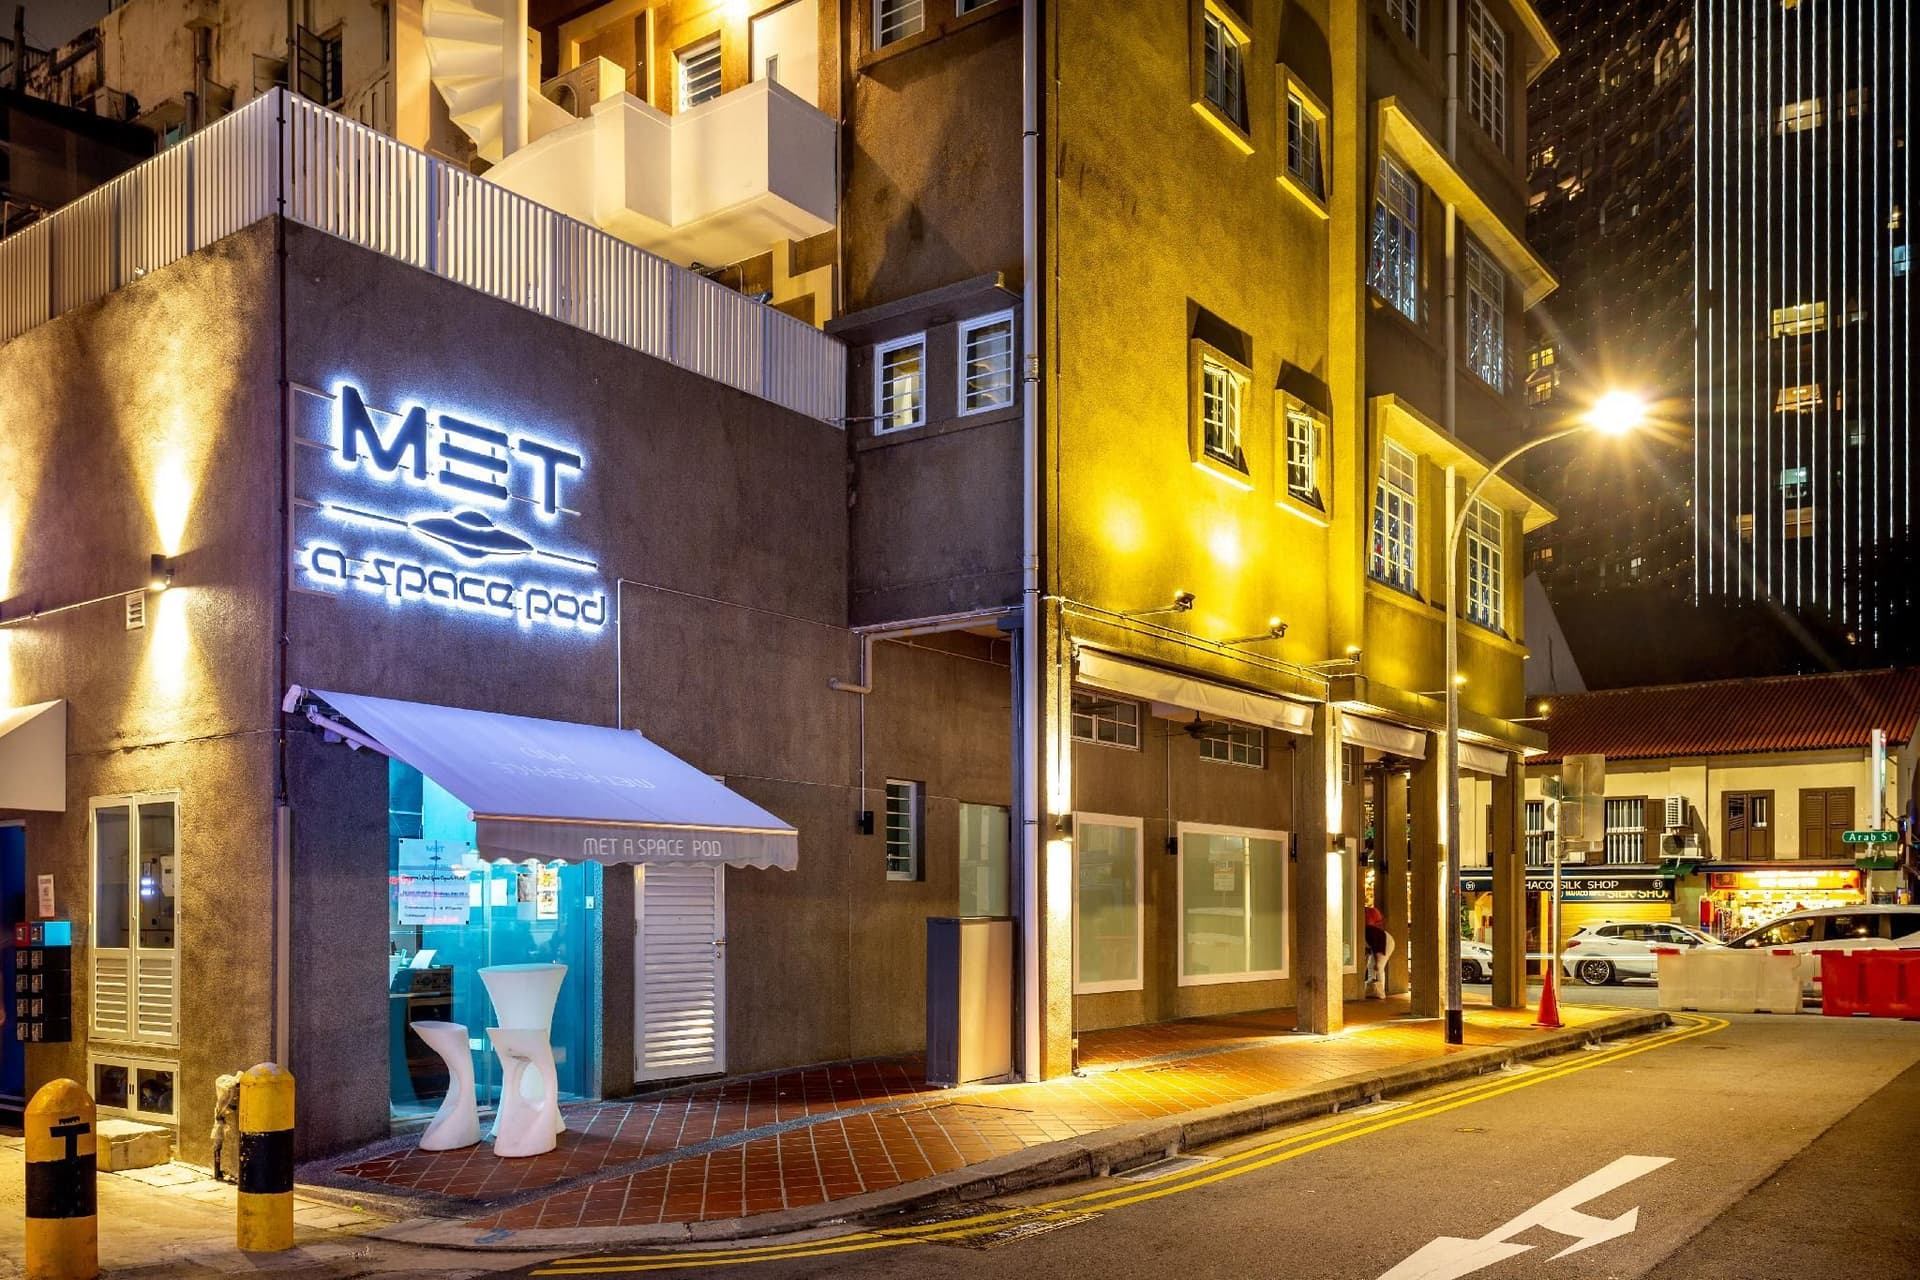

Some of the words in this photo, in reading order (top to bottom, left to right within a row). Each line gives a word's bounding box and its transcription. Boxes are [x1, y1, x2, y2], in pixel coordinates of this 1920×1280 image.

[342, 385, 582, 514] MET
[364, 557, 515, 610] space
[525, 589, 606, 626] pod
[583, 837, 618, 855] MET
[624, 838, 634, 855] A
[638, 838, 684, 856] SPACE
[693, 840, 722, 857] POD
[1849, 832, 1876, 842] Arab
[1881, 832, 1892, 842] St
[1525, 881, 1554, 890] HACO
[1560, 881, 1582, 889] SILK
[1587, 881, 1619, 889] SHOP
